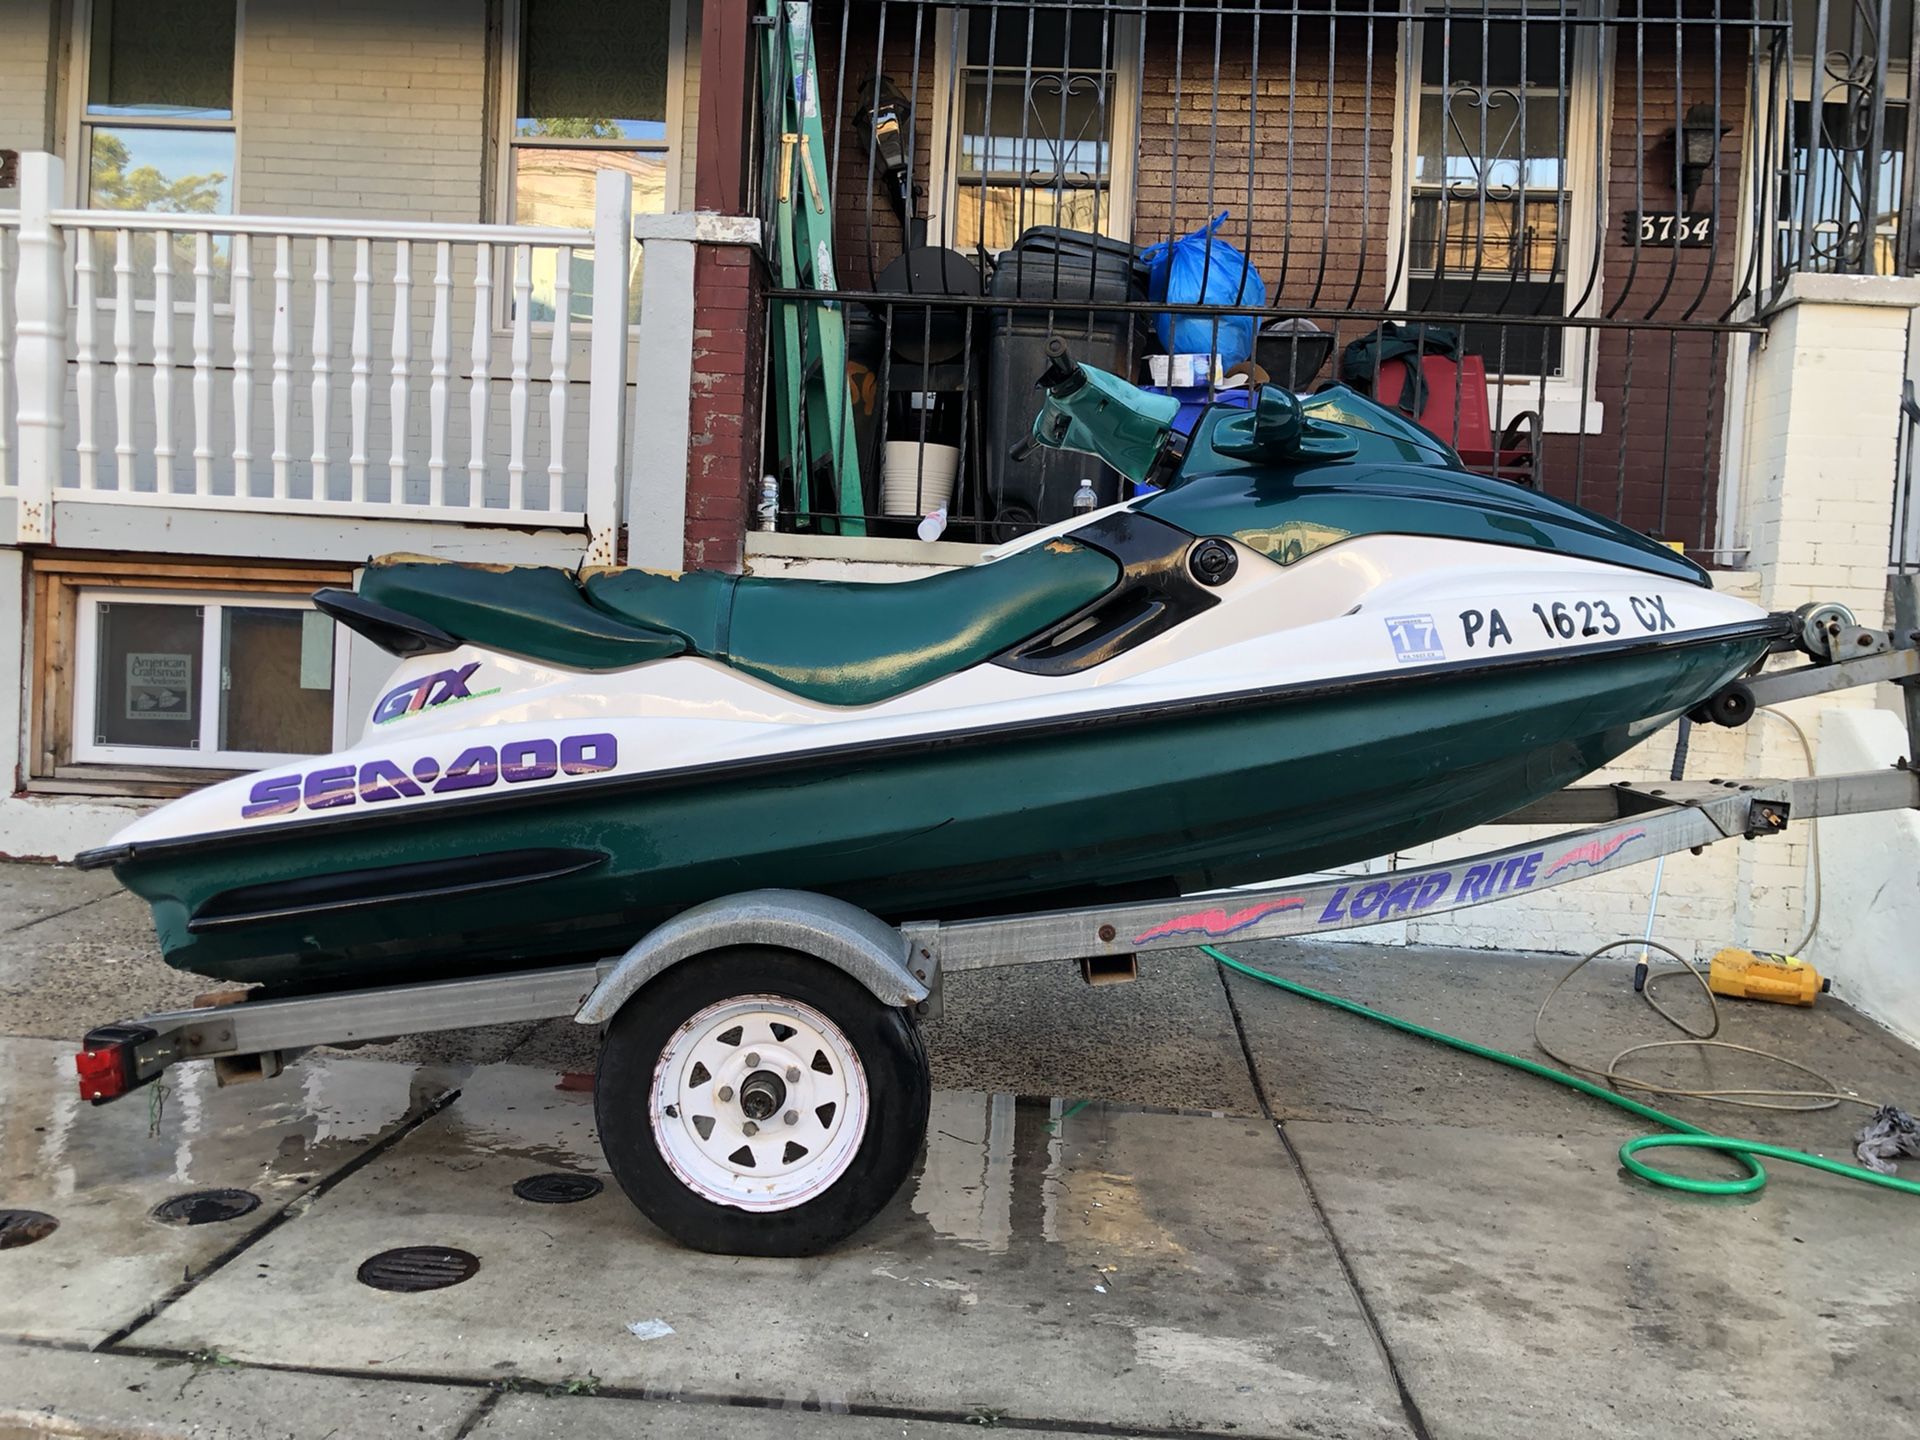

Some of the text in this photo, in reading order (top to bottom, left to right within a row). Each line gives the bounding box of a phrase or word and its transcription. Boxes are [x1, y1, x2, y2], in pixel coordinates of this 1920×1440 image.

[1640, 216, 1710, 241] 3754
[1459, 595, 1676, 648] PA 1623 CX
[1392, 623, 1433, 651] 17
[131, 668, 186, 677] Craftsman
[132, 656, 186, 669] American
[373, 662, 481, 724] GTX
[1318, 852, 1544, 924] LOAD RITE
